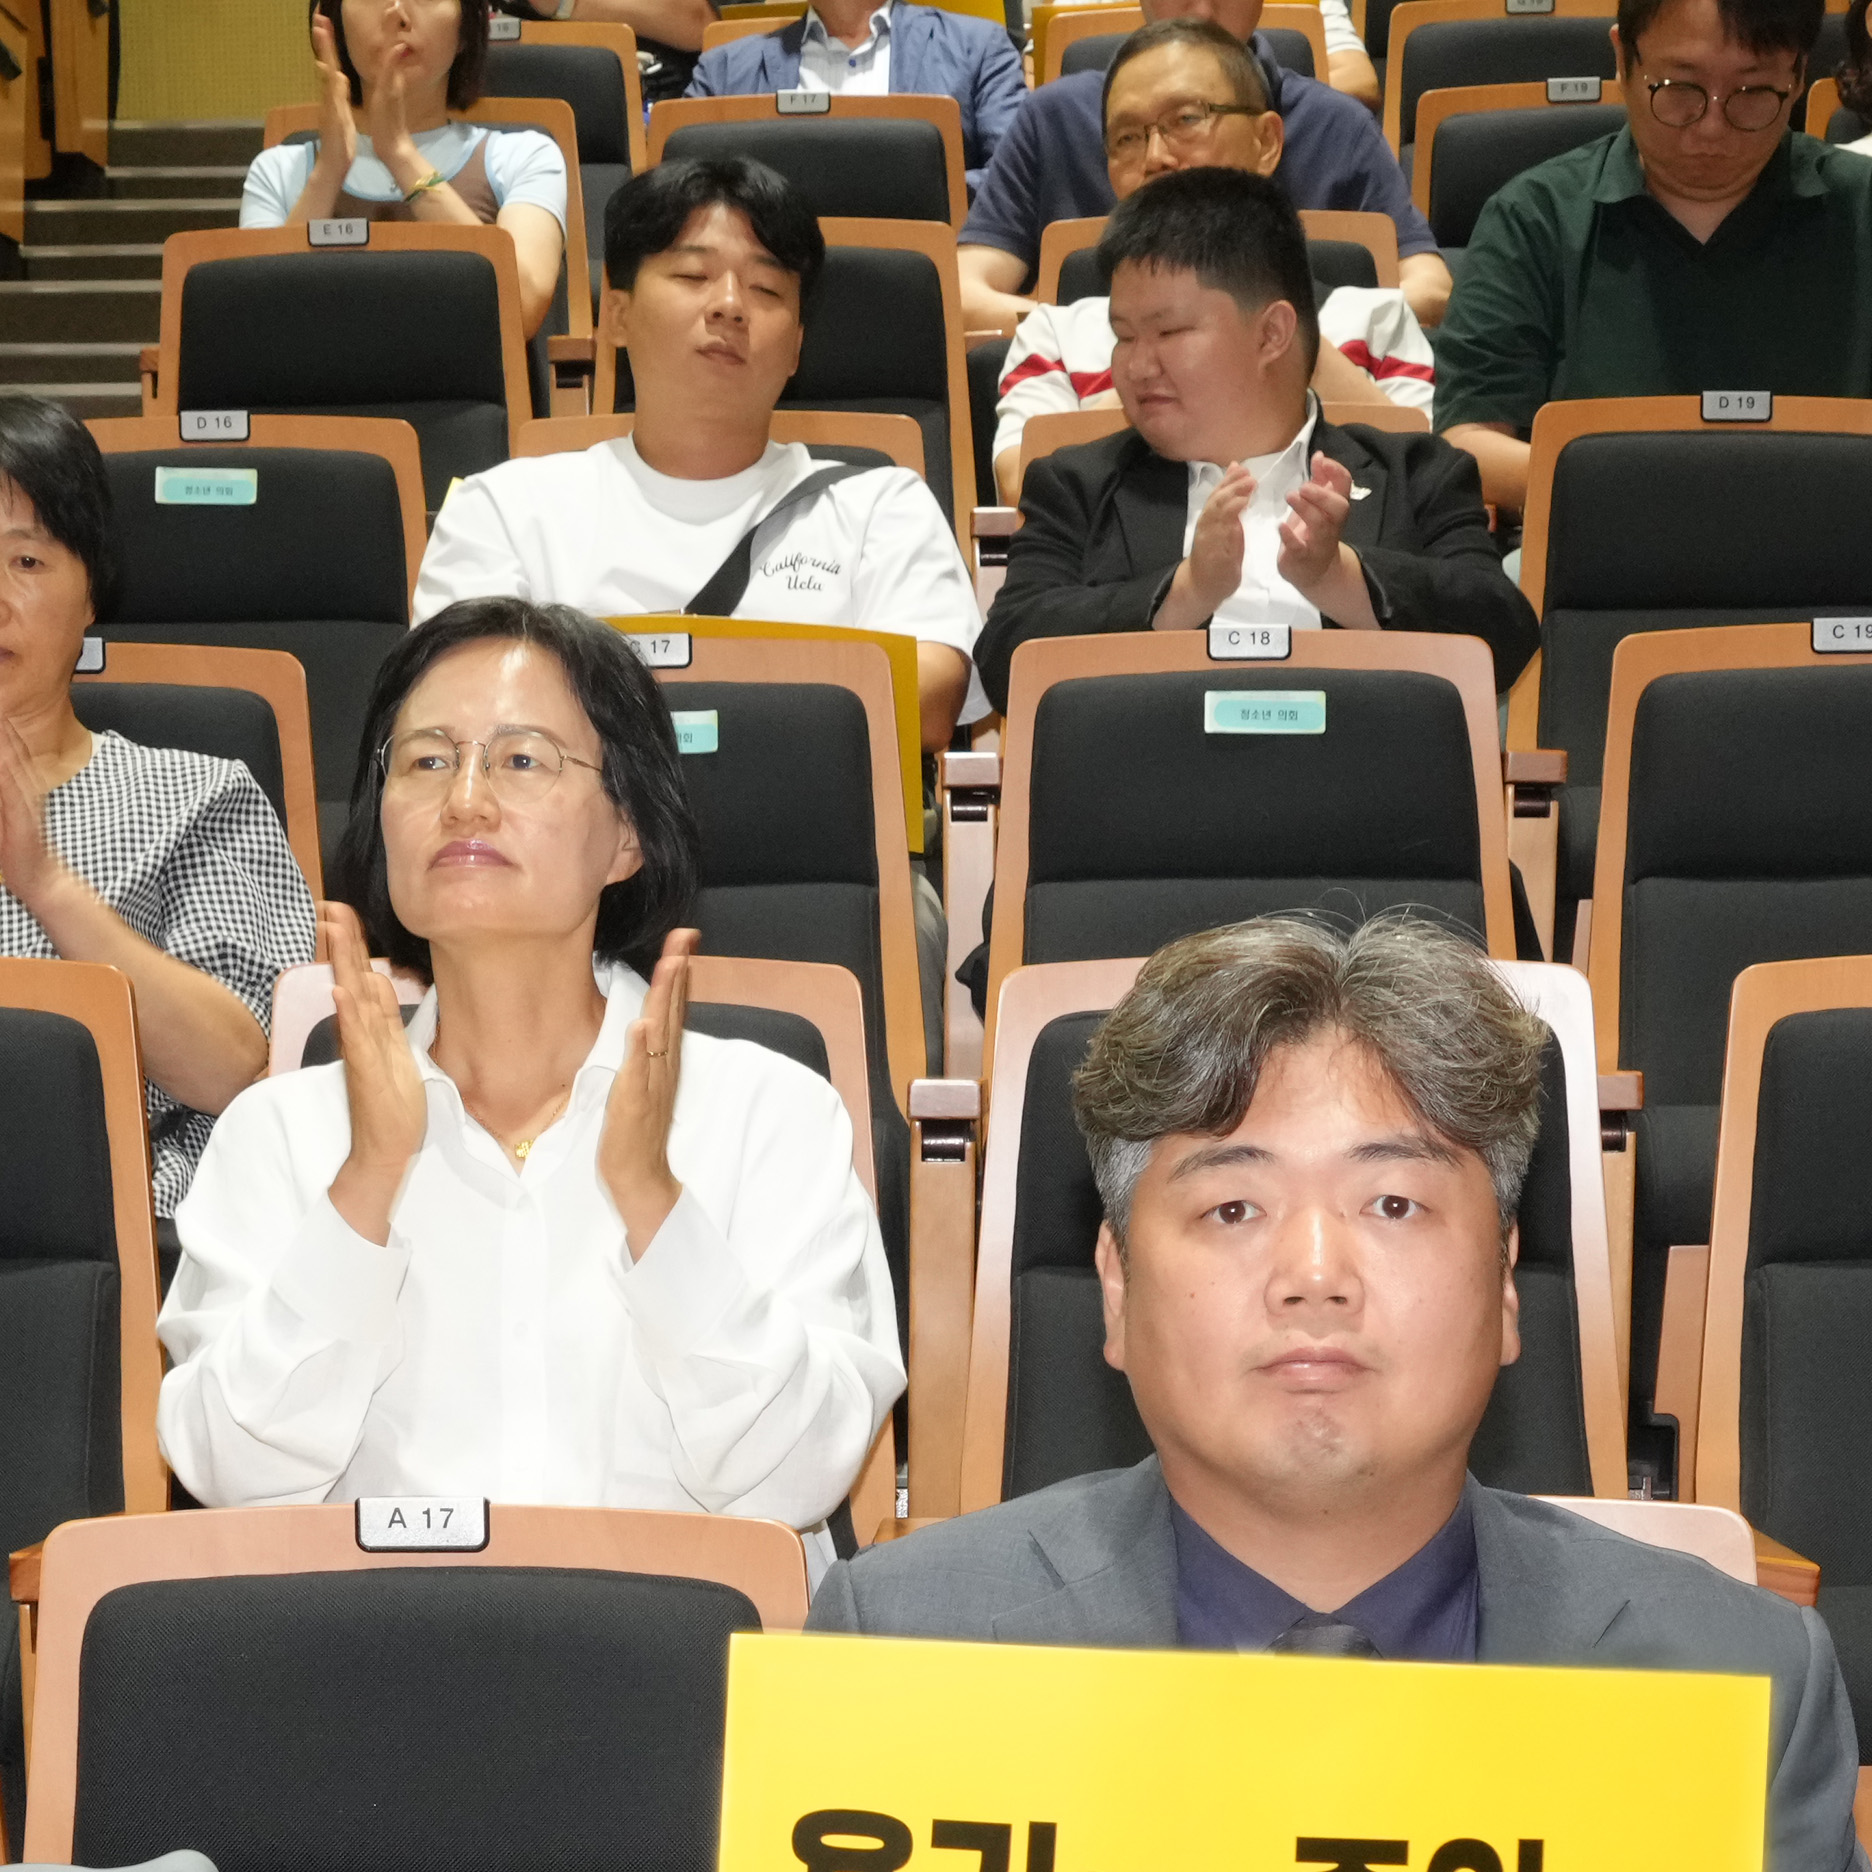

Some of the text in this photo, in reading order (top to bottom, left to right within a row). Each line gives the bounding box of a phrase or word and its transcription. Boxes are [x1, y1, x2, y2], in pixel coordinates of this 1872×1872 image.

[790, 94, 818, 105] F 17
[323, 223, 354, 236] E 16
[1718, 396, 1755, 409] D 19
[196, 416, 232, 430] D 16
[759, 552, 842, 579] California
[786, 575, 823, 592] Ucla
[1228, 631, 1271, 646] C 18
[1832, 624, 1845, 639] C
[651, 639, 671, 654] 17
[1277, 709, 1299, 721] 의회
[387, 1506, 455, 1529] A 17
